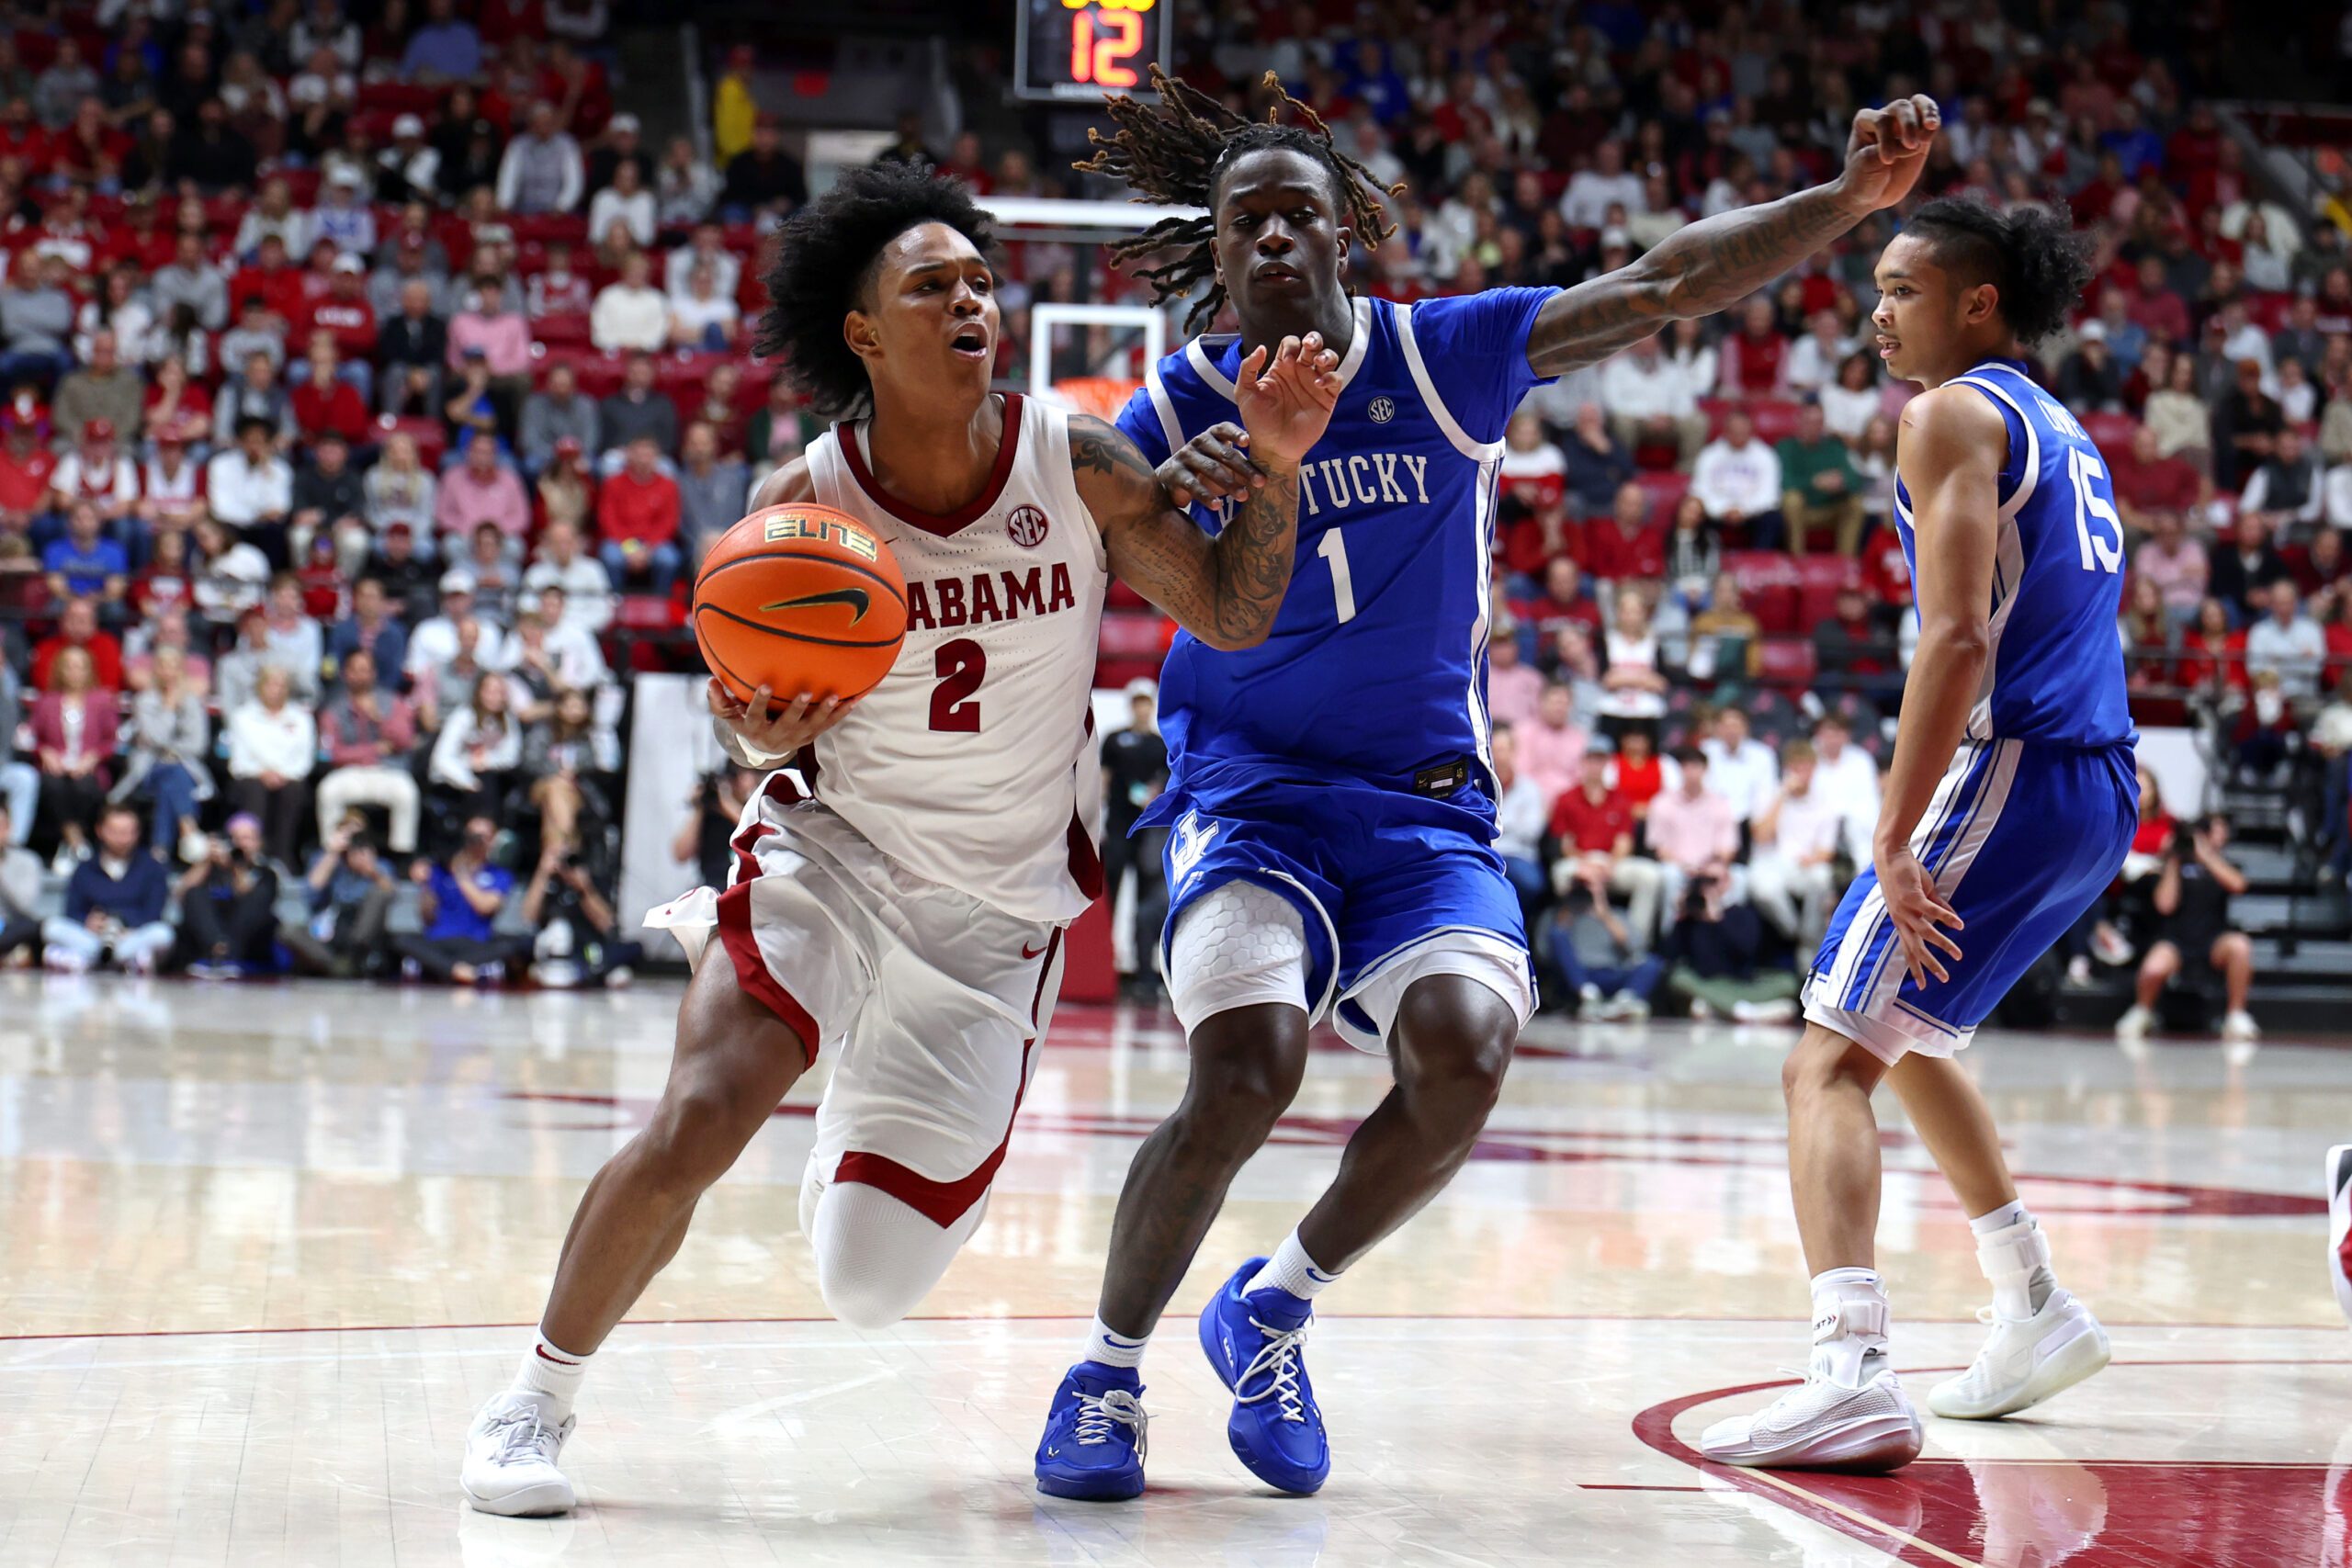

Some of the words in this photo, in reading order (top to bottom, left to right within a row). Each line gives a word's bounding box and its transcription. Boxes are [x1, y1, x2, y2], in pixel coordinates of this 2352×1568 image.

[1071, 9, 1144, 87] 12
[1370, 397, 1394, 423] SEC
[1299, 453, 1430, 515] TUCKY
[2068, 445, 2124, 574] 15
[764, 514, 877, 562] ELITE
[1009, 507, 1046, 547] SEC
[907, 561, 1075, 632] ABAMA
[1317, 526, 1356, 625] 1
[928, 637, 987, 732] 2
